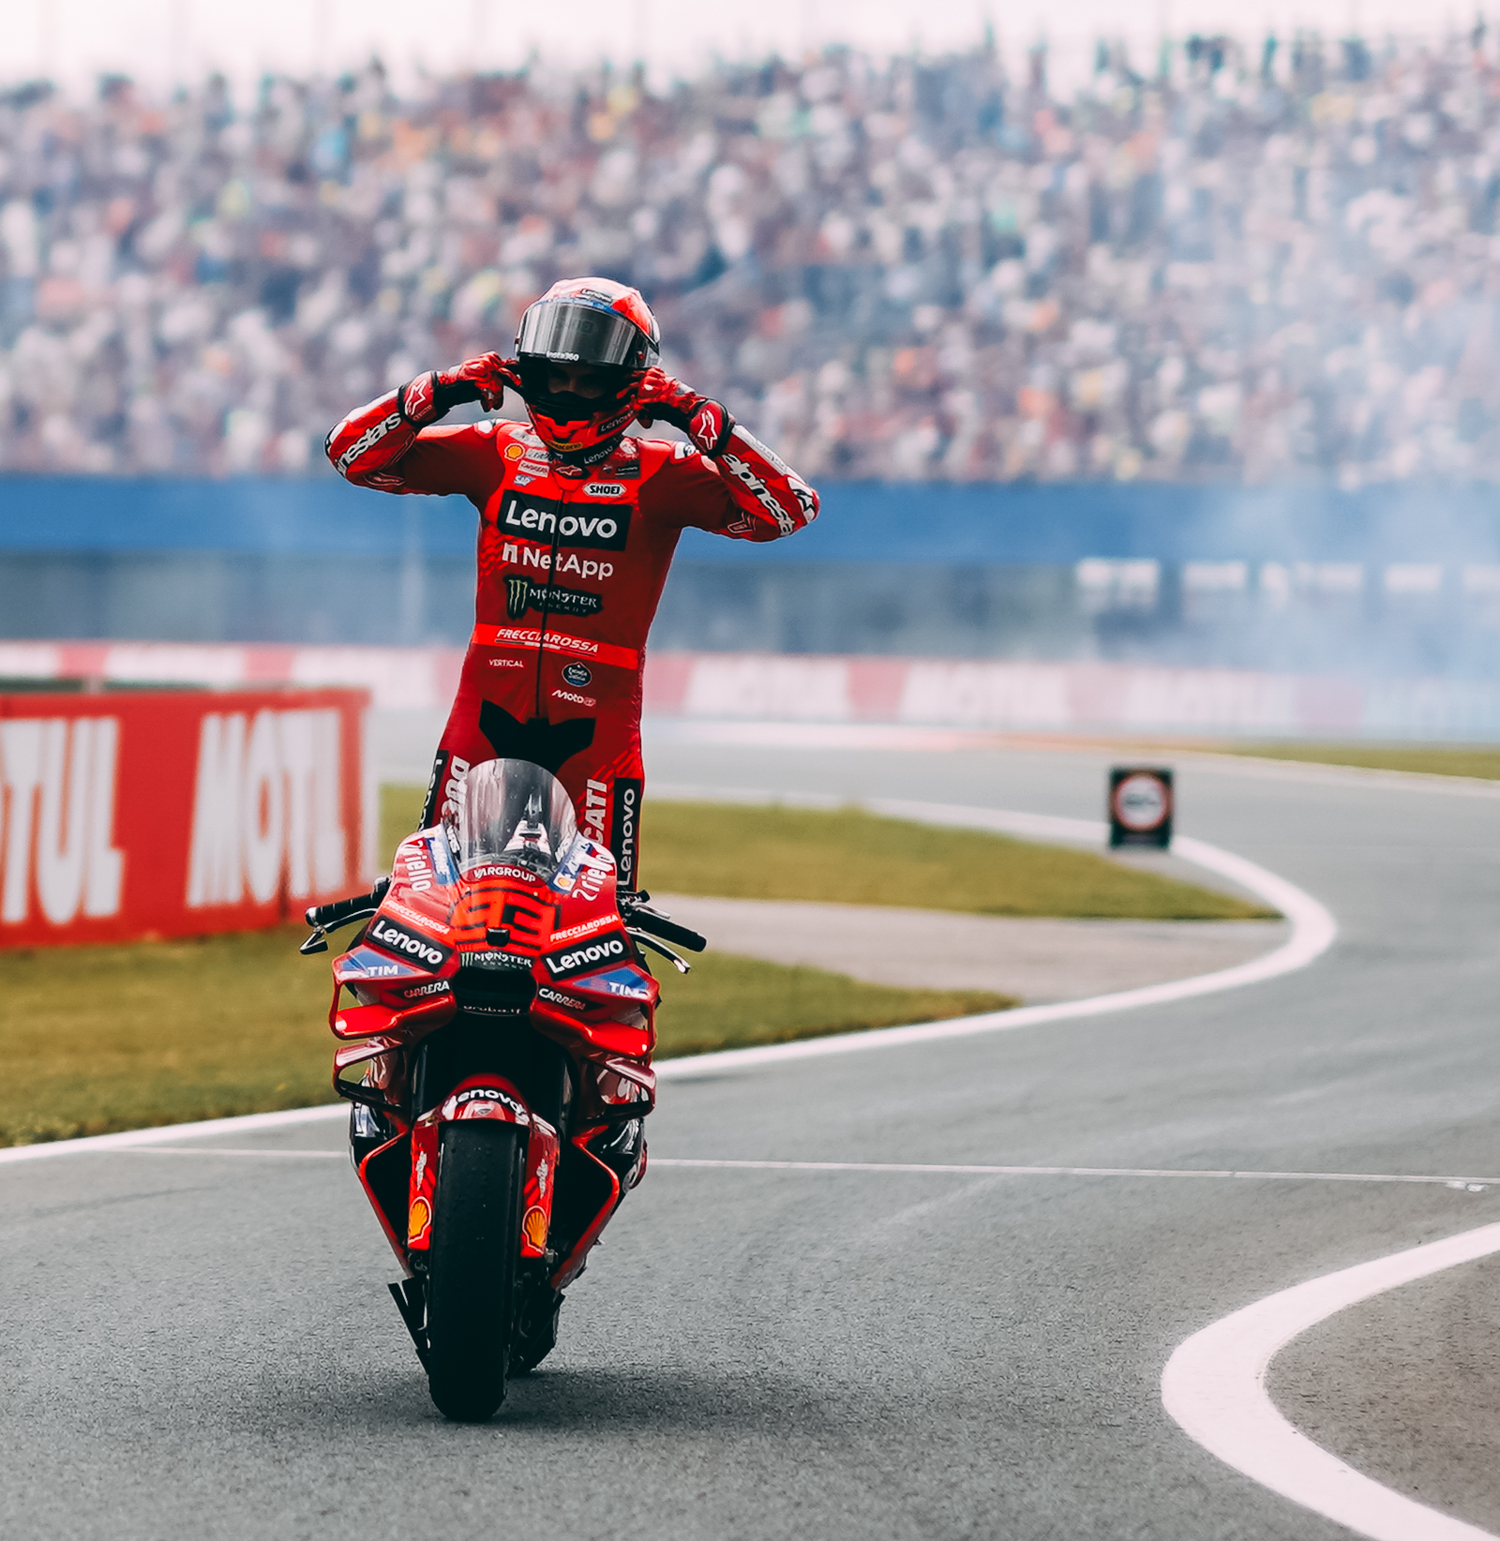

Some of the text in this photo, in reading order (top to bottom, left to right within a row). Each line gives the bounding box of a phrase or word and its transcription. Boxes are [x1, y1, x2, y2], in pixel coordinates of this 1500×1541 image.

[335, 412, 402, 477] inestars
[589, 484, 621, 494] SHOEI
[721, 453, 795, 536] alpinesta
[505, 500, 618, 539] Lenovo
[522, 546, 614, 581] NetApp
[529, 587, 598, 608] MONSTER
[496, 628, 599, 653] FRECCIAROSSA
[488, 659, 524, 668] VERTICAL
[583, 778, 607, 844] CATI
[617, 788, 635, 886] Lenovo
[473, 866, 536, 882] VARGROUP
[550, 914, 619, 942] FRECCIAROSSA
[372, 920, 443, 964] Lenovo
[474, 951, 533, 968] MONSTER
[546, 940, 624, 974] Lenovo
[367, 965, 398, 977] TIM
[404, 980, 450, 998] CARRERA
[538, 987, 587, 1010] CARRERA
[609, 982, 640, 997] TIM
